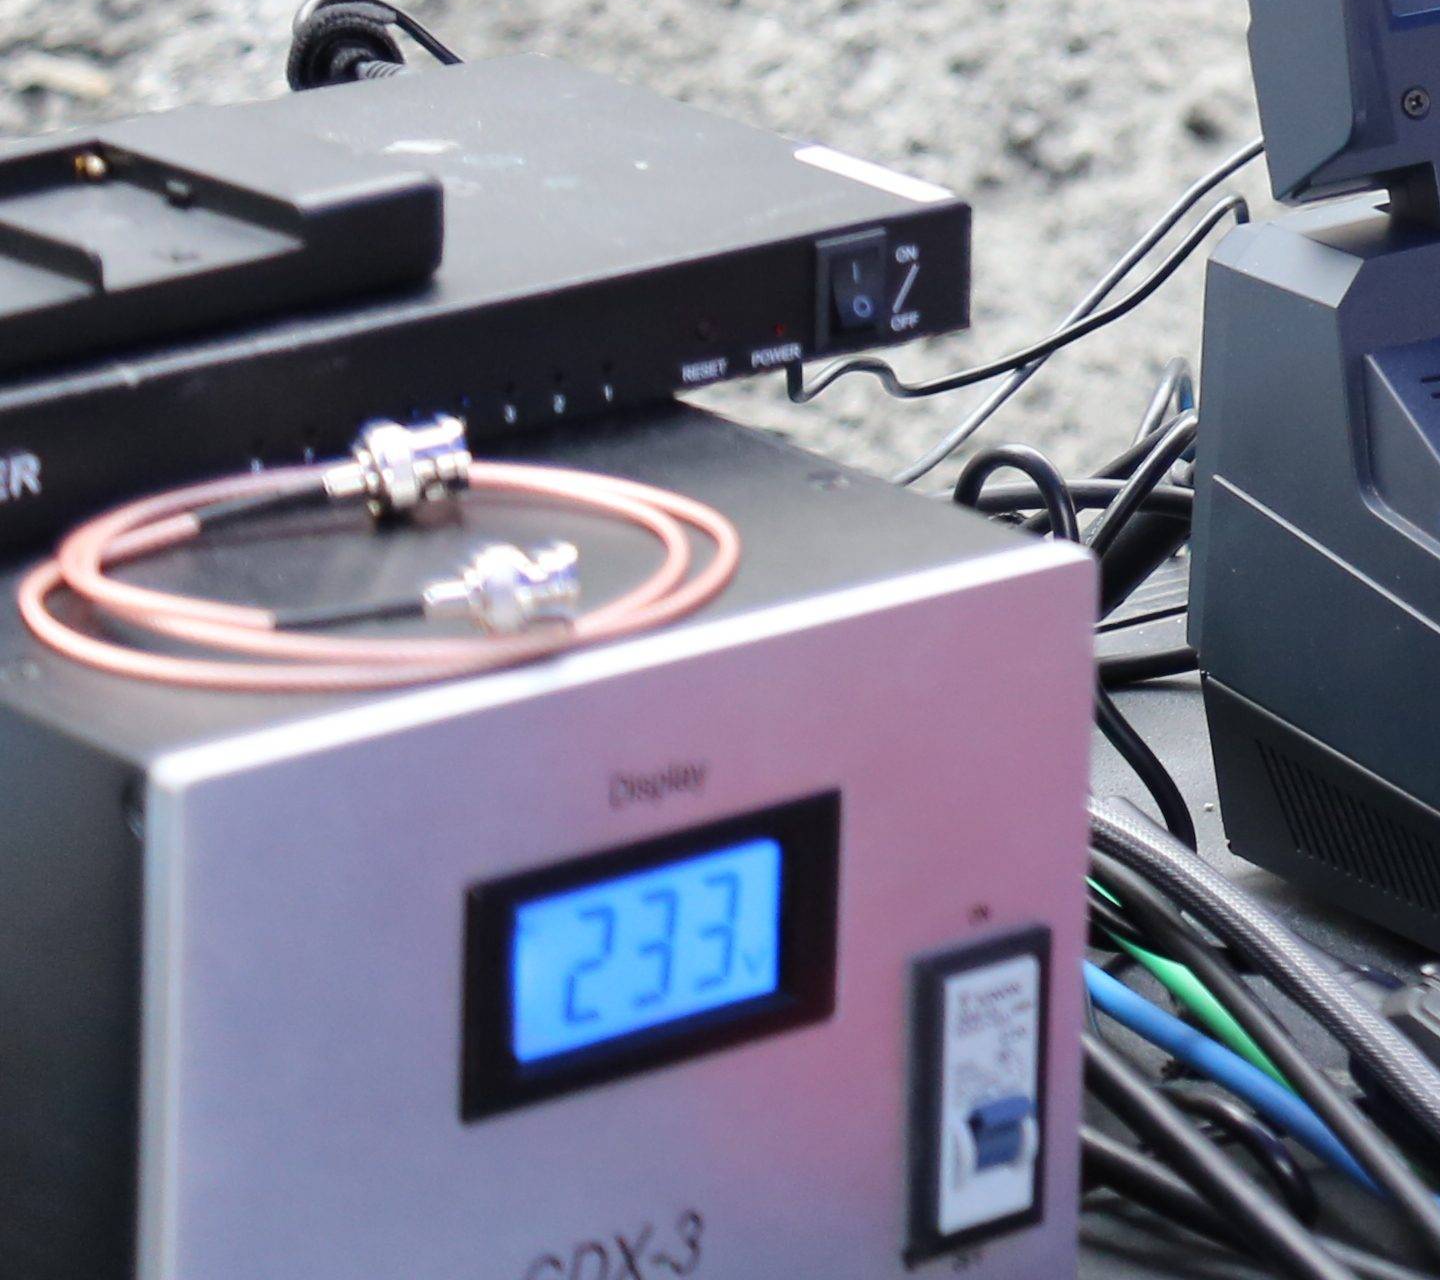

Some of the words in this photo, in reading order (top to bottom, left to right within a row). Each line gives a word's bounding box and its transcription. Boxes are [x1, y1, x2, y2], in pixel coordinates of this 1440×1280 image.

[895, 245, 919, 265] ON
[890, 310, 920, 331] OFF
[751, 342, 800, 368] POWER
[682, 357, 728, 383] RESET
[607, 761, 706, 810] Display
[564, 870, 740, 1028] 233
